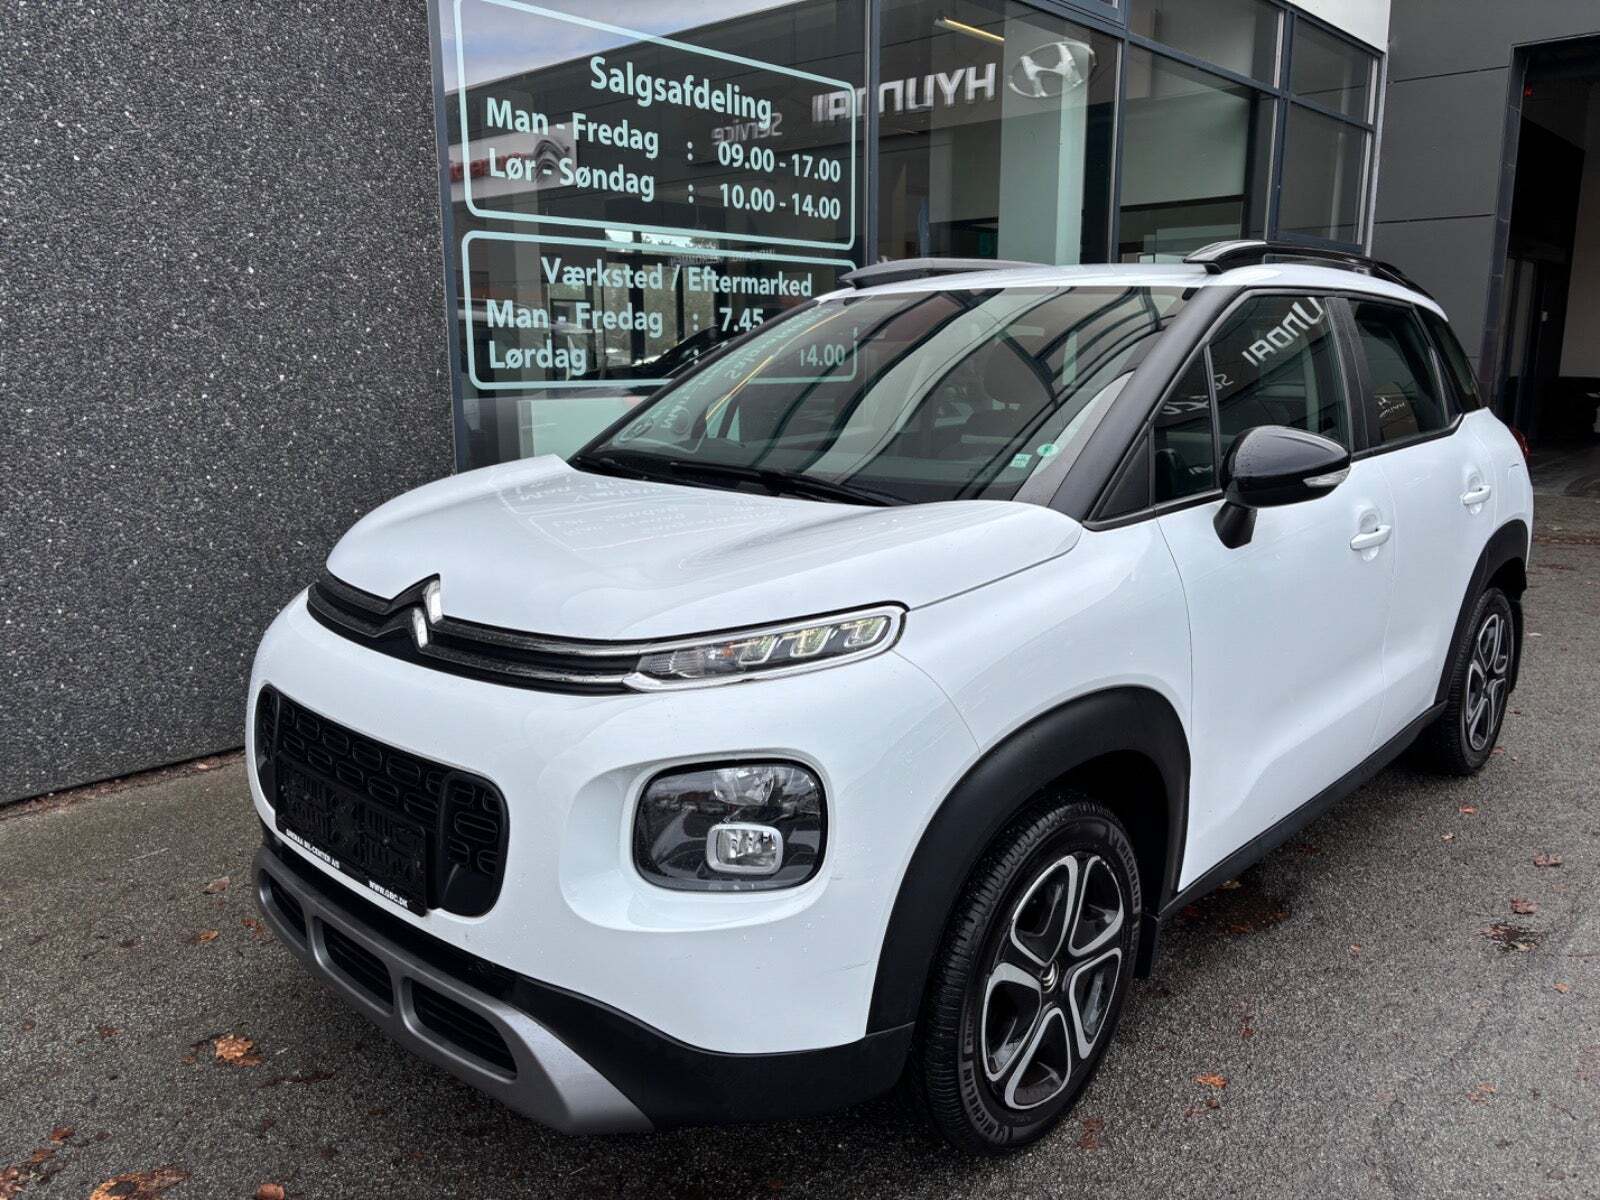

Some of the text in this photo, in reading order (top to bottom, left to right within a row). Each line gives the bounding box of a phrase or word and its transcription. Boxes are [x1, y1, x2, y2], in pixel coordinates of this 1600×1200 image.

[590, 56, 772, 128] Salgsafdeling
[486, 97, 549, 136] Man
[572, 112, 659, 160] Fredag
[717, 141, 775, 173] 09.00
[792, 153, 841, 183] 17.00
[489, 147, 536, 180] Lør
[559, 157, 655, 203] Søndag
[719, 183, 775, 213] 10.00
[792, 192, 841, 220] 14.00
[541, 256, 663, 289] Værksted
[688, 266, 812, 297] Eftermarked
[486, 299, 549, 329] Man
[576, 301, 663, 337] Fredag
[719, 307, 764, 331] 7.45
[489, 339, 587, 374] Lørdag
[963, 1068, 997, 1136] MICHELIN
